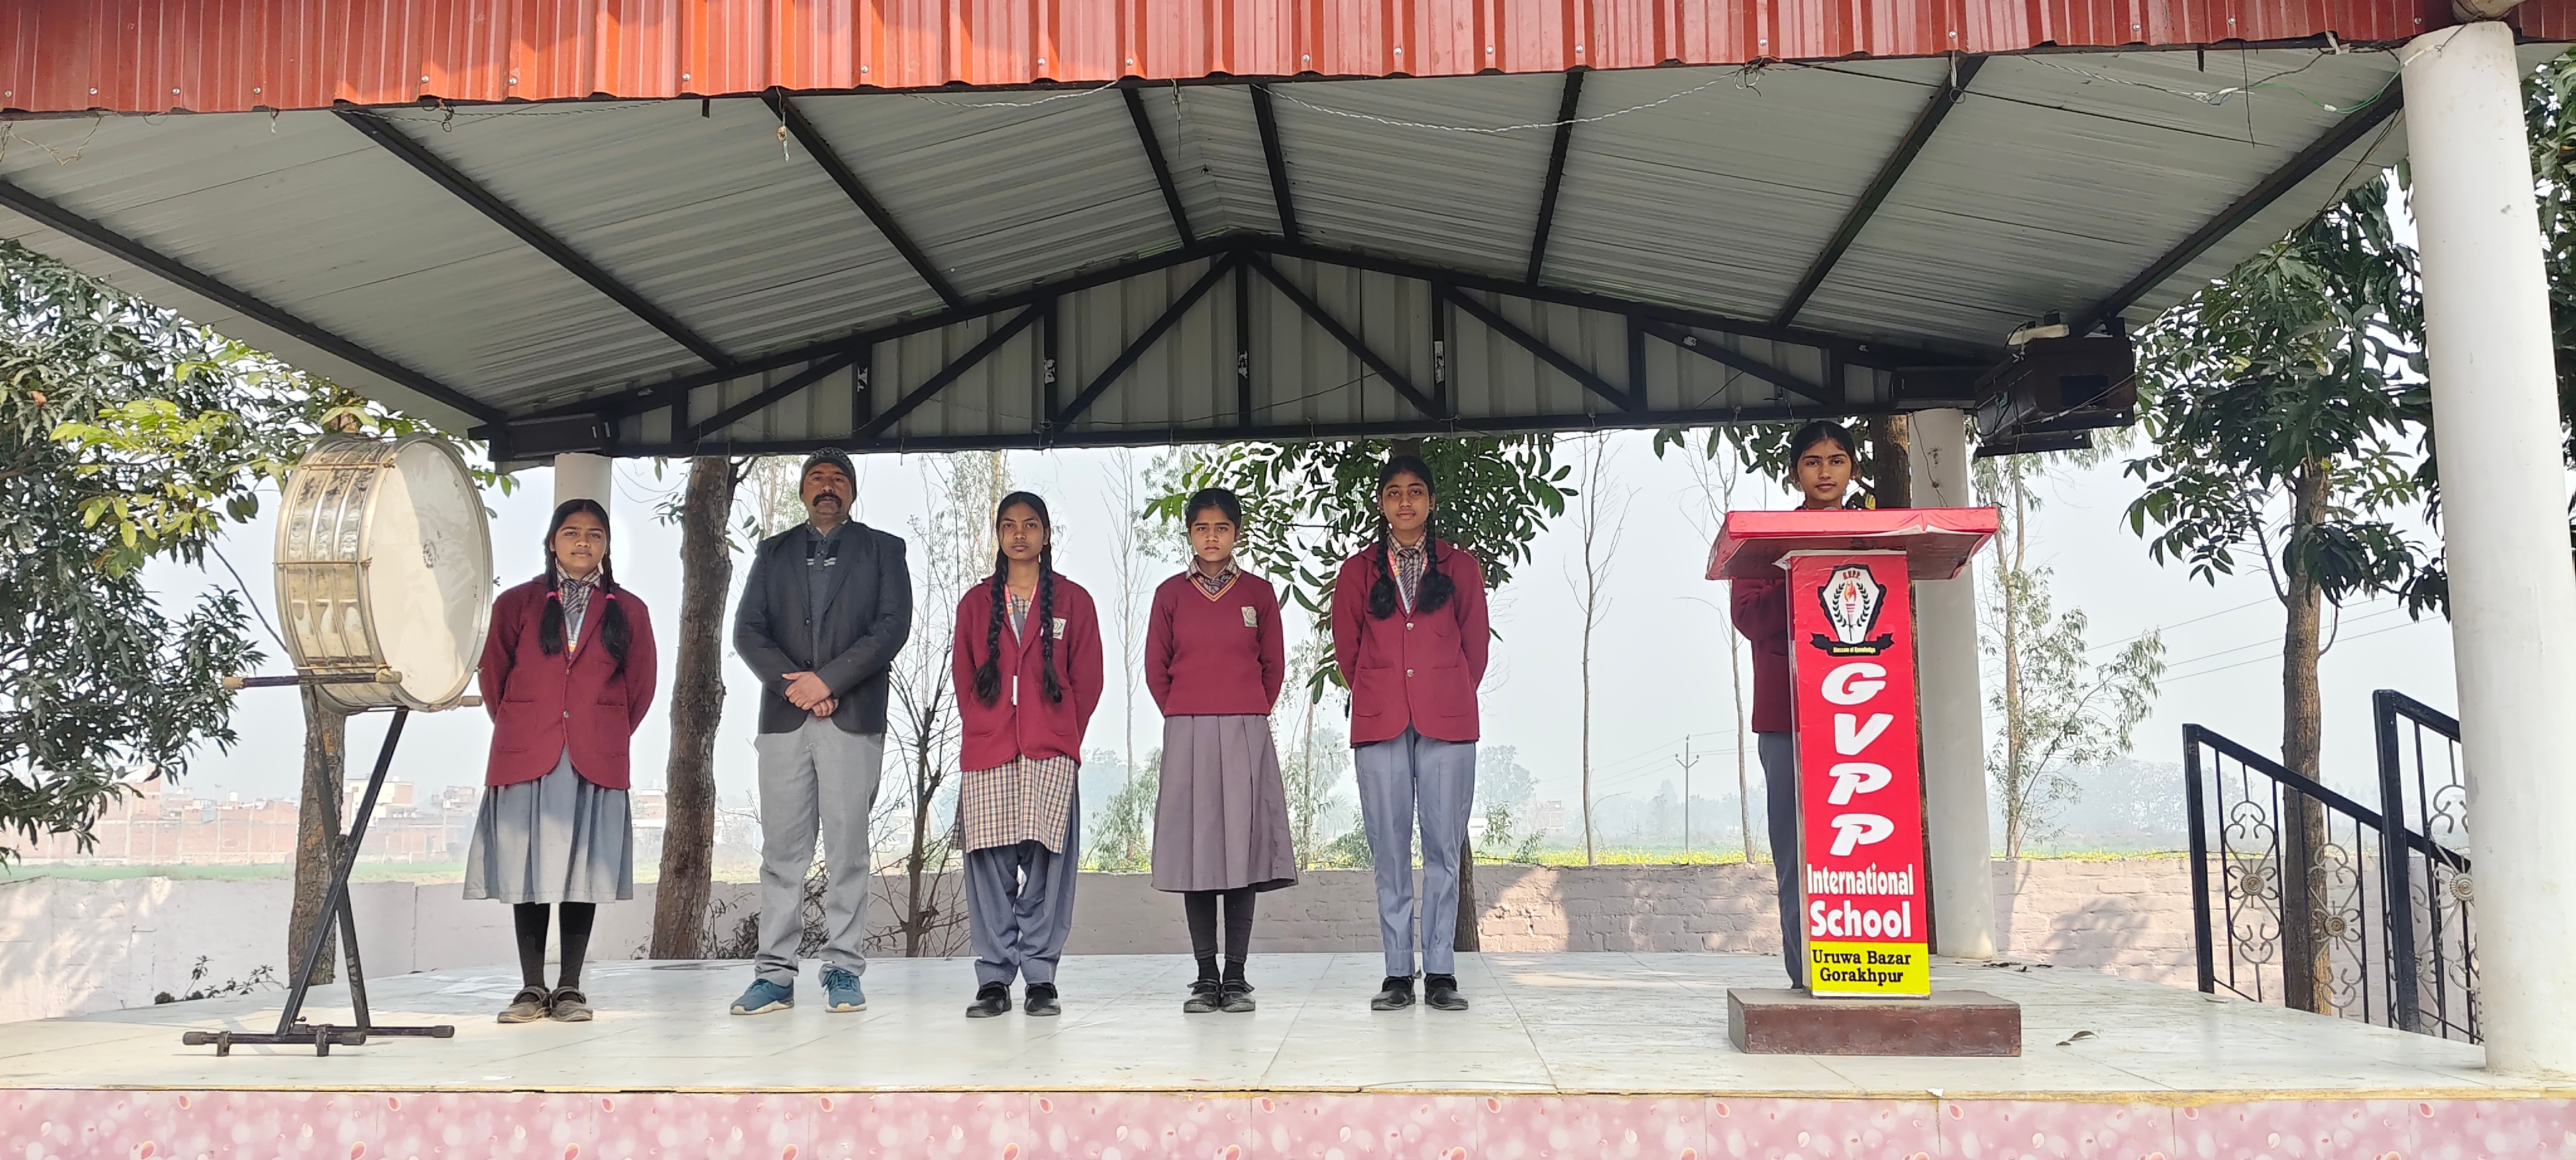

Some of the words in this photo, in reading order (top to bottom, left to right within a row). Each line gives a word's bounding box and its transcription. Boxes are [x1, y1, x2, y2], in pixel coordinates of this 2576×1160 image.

[1807, 861, 1914, 895] International
[1811, 900, 1911, 937] School
[1813, 949, 1861, 963] Uruwa
[1867, 951, 1911, 965] Bazar
[1820, 967, 1903, 986] Gorakhpur
